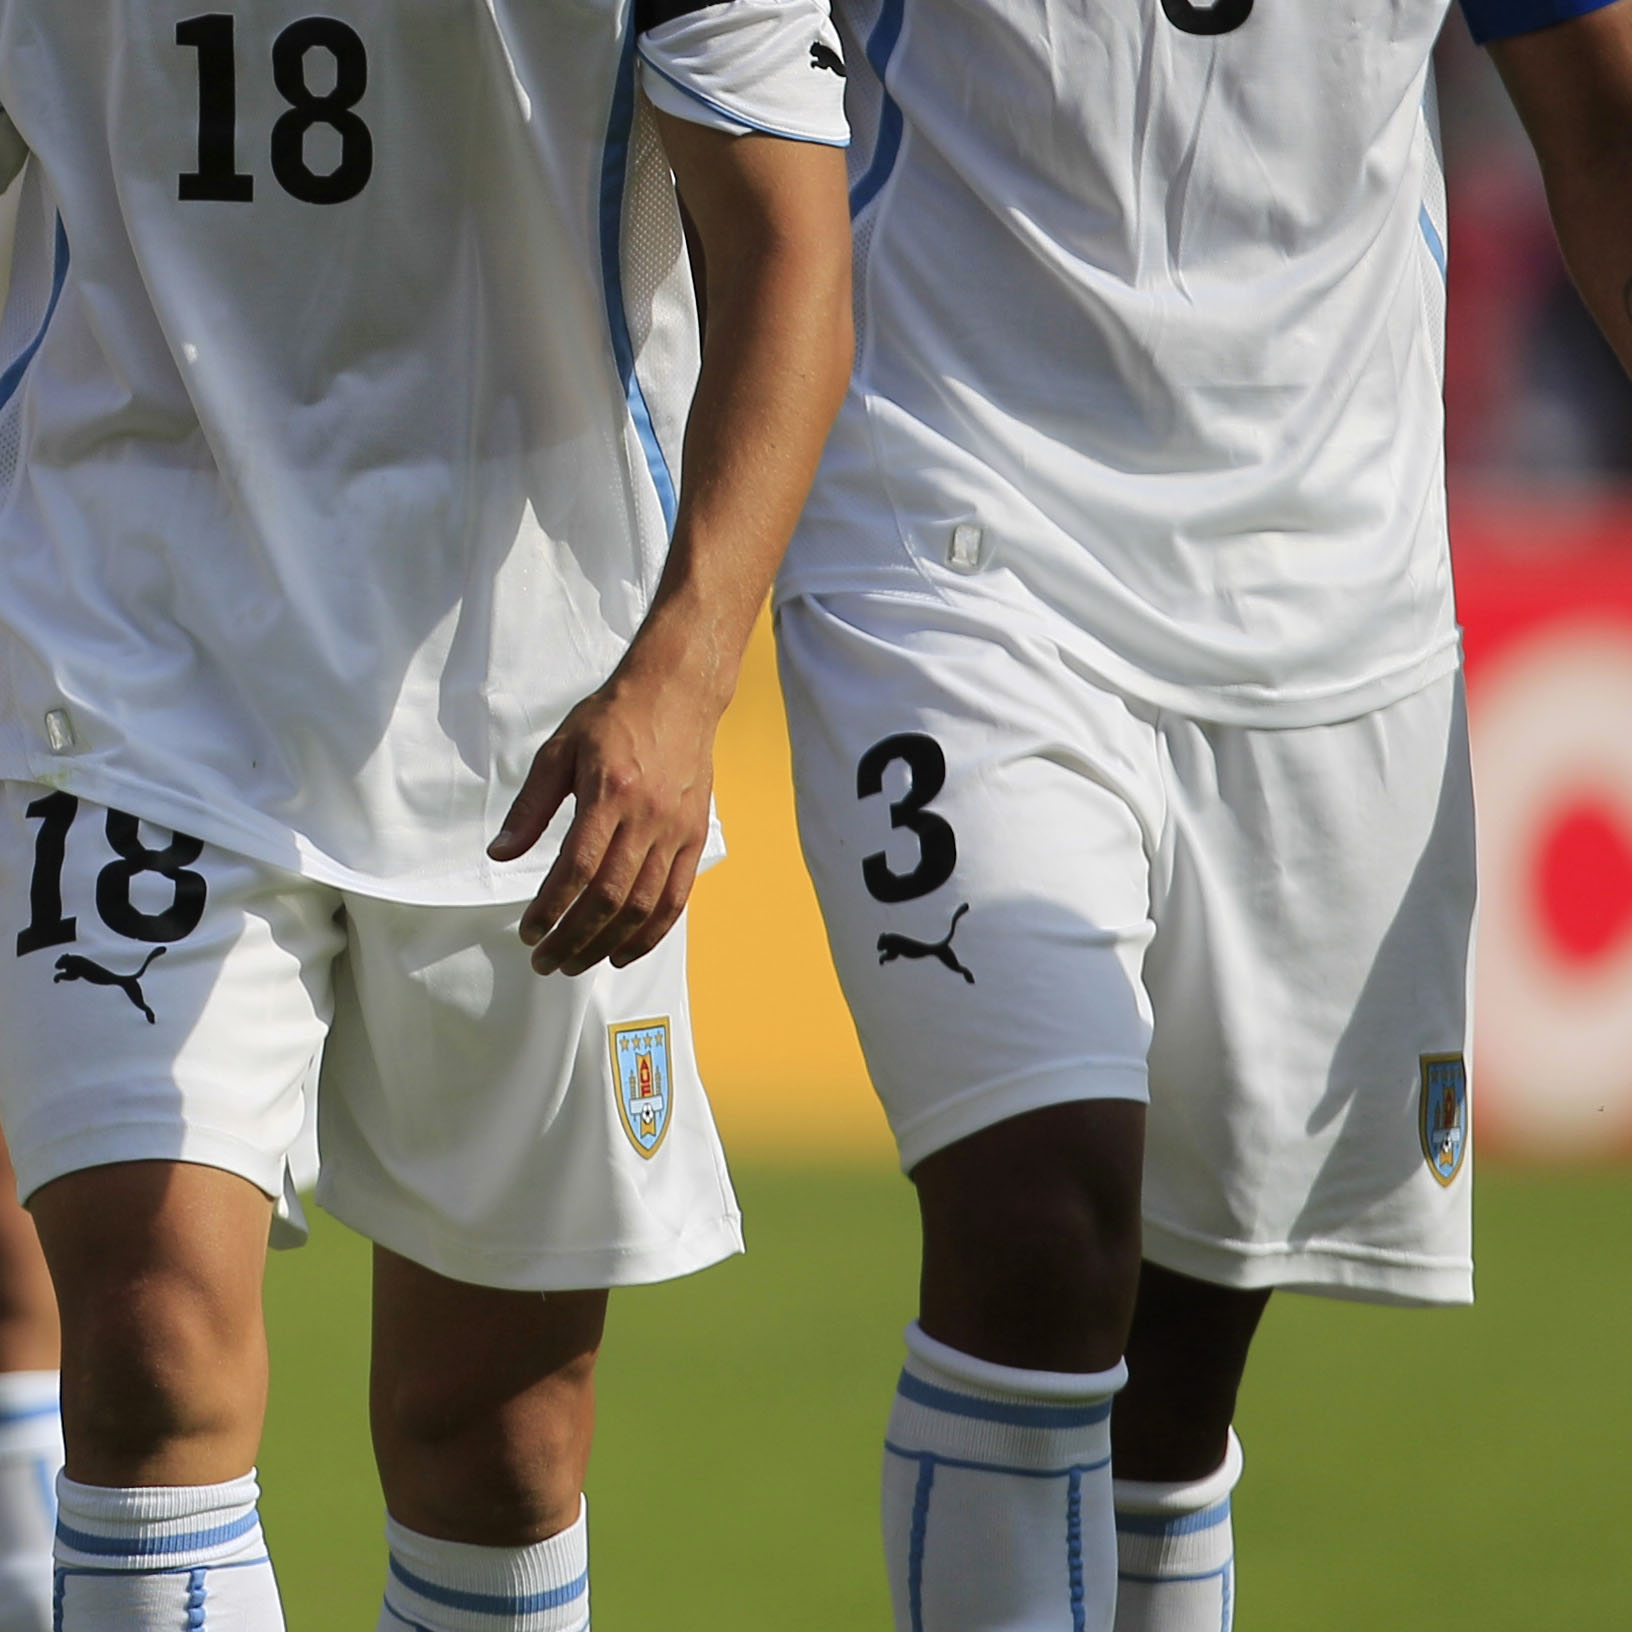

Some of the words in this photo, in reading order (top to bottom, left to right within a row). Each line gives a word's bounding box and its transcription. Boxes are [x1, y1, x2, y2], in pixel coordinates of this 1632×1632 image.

[175, 13, 374, 207] 18
[16, 789, 208, 958] 18
[856, 732, 957, 905] 3
